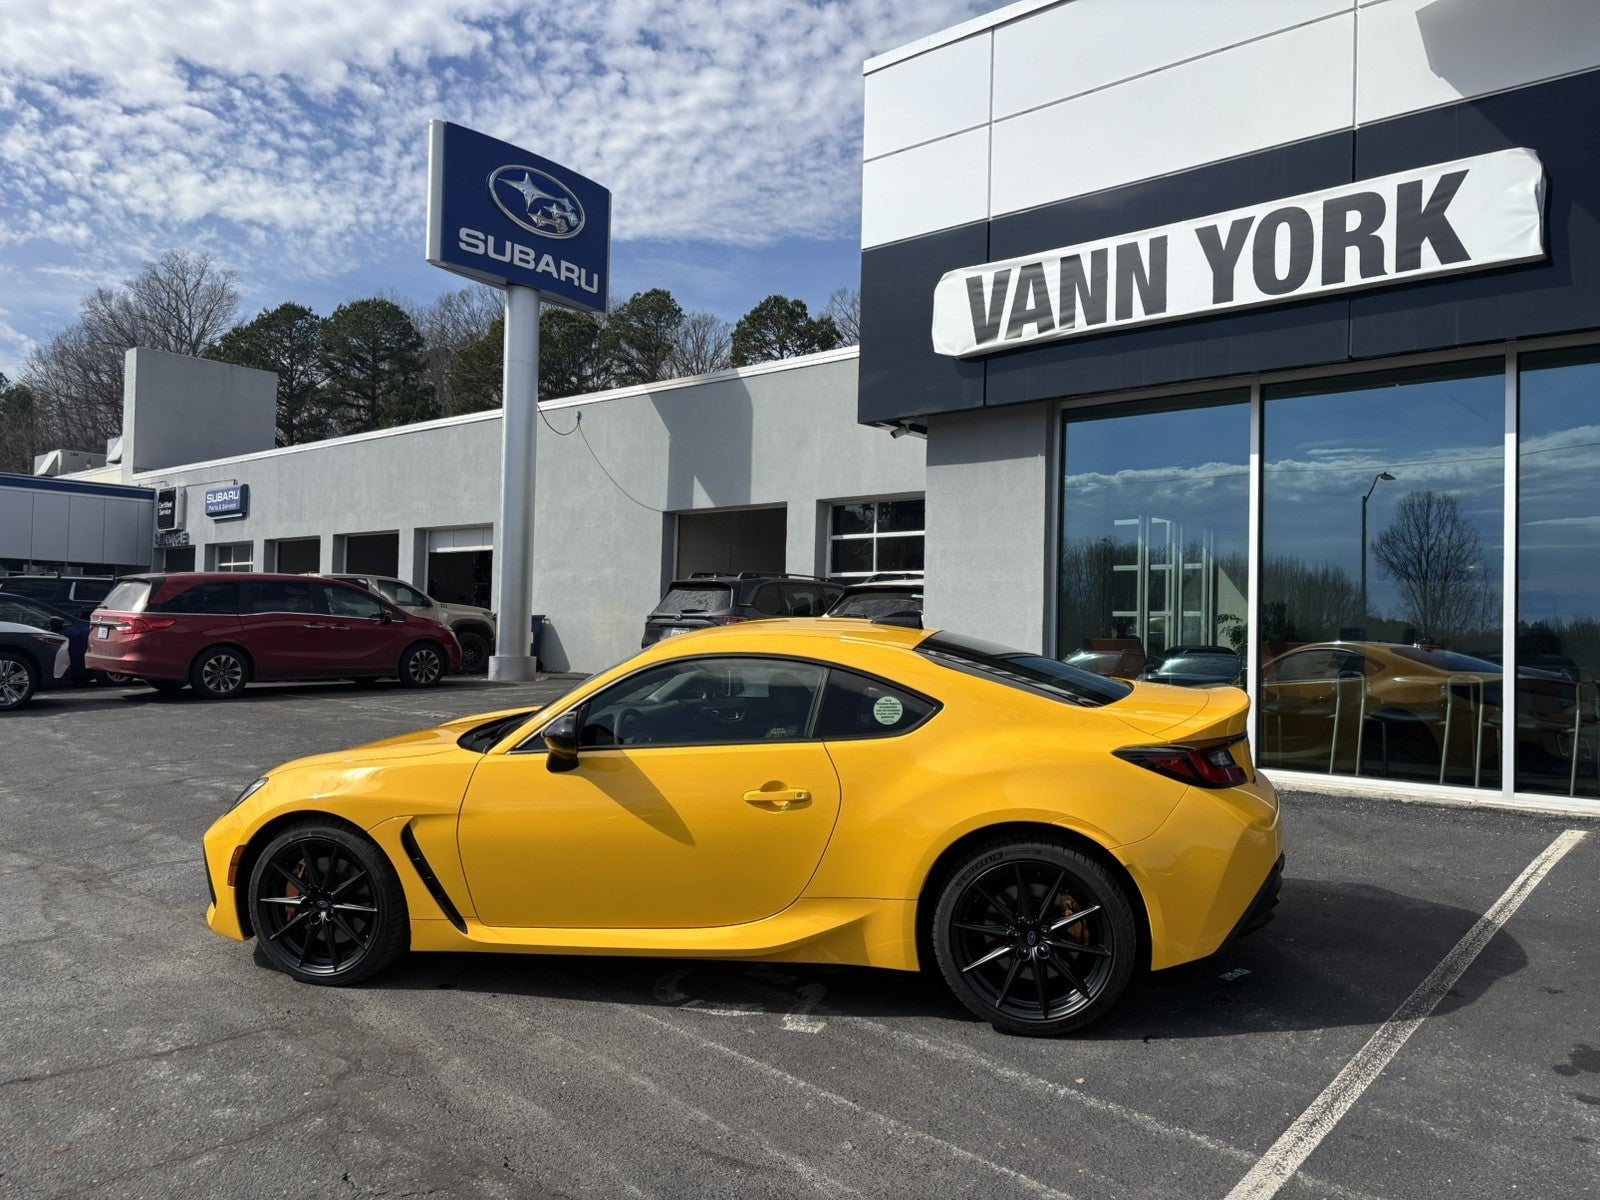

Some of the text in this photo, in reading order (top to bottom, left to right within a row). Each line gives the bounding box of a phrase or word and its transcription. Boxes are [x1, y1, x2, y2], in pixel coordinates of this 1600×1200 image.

[458, 227, 599, 294] SUBARU
[966, 169, 1471, 345] VANN YORK
[206, 490, 240, 503] SUBARU
